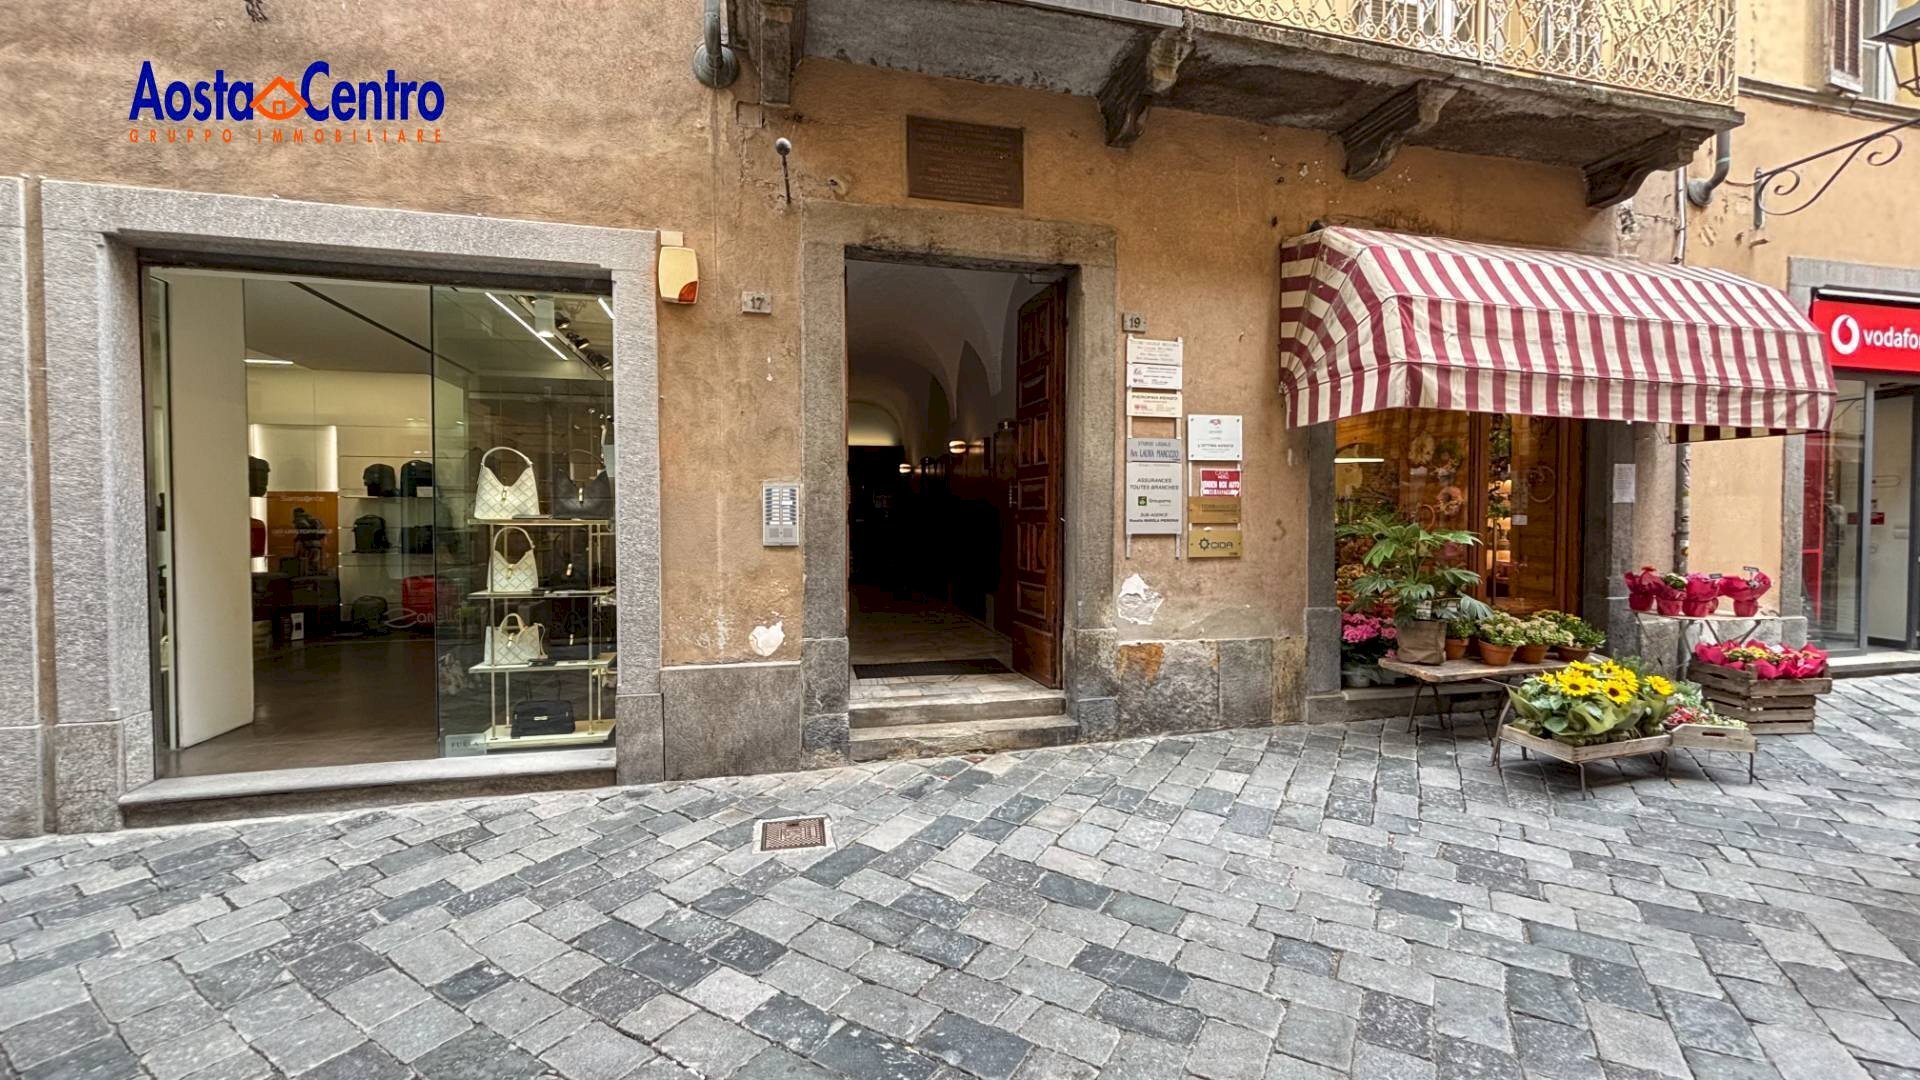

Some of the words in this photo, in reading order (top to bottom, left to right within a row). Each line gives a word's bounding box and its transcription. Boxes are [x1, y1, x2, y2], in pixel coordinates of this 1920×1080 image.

[751, 296, 766, 311] 17
[1129, 317, 1142, 329] 19
[1862, 326, 1920, 350] vodafo
